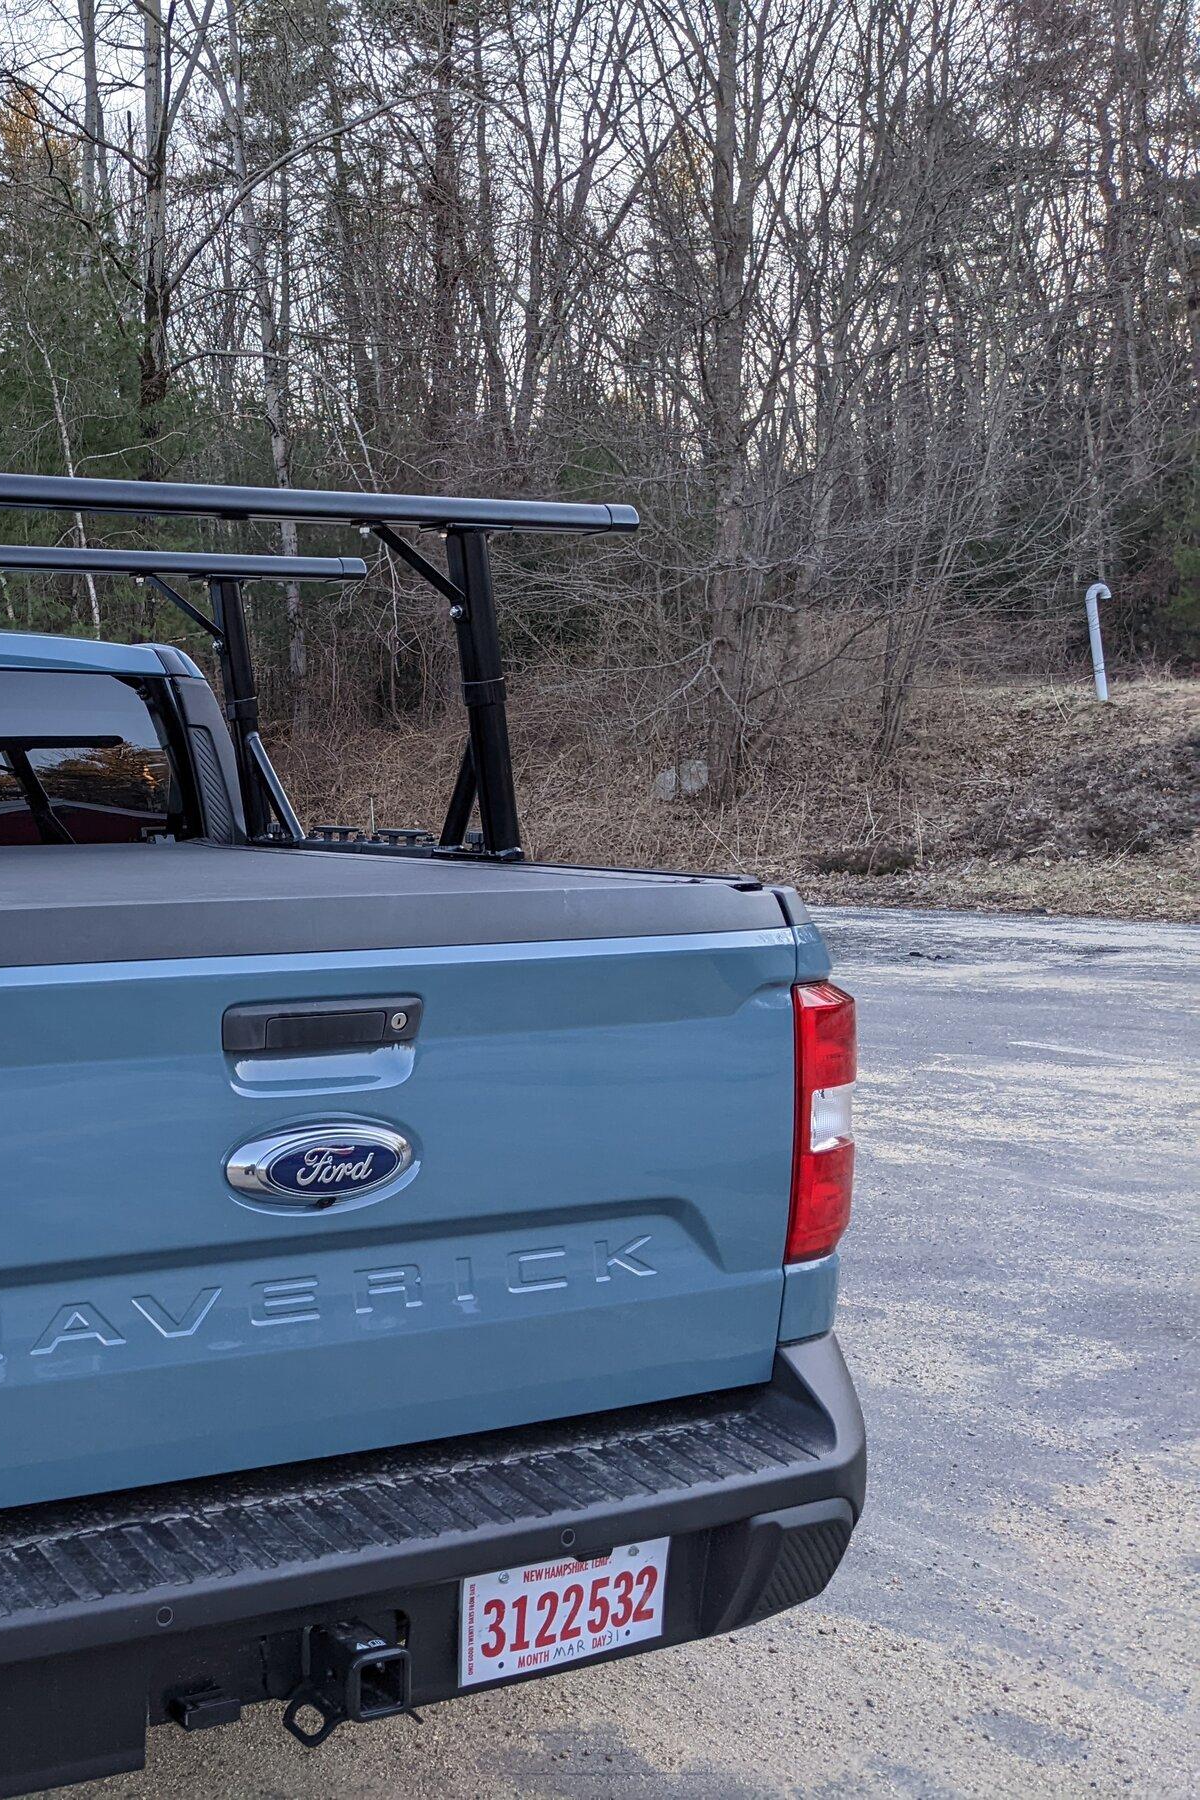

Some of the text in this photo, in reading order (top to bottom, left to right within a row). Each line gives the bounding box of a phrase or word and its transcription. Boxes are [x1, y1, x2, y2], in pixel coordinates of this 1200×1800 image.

[296, 1146, 375, 1186] Ford
[523, 1567, 545, 1583] NEW
[544, 1561, 589, 1580] HAMPSHIRE
[480, 1565, 658, 1658] 3122532
[517, 1629, 619, 1668] MONTH MAR DAY 31
